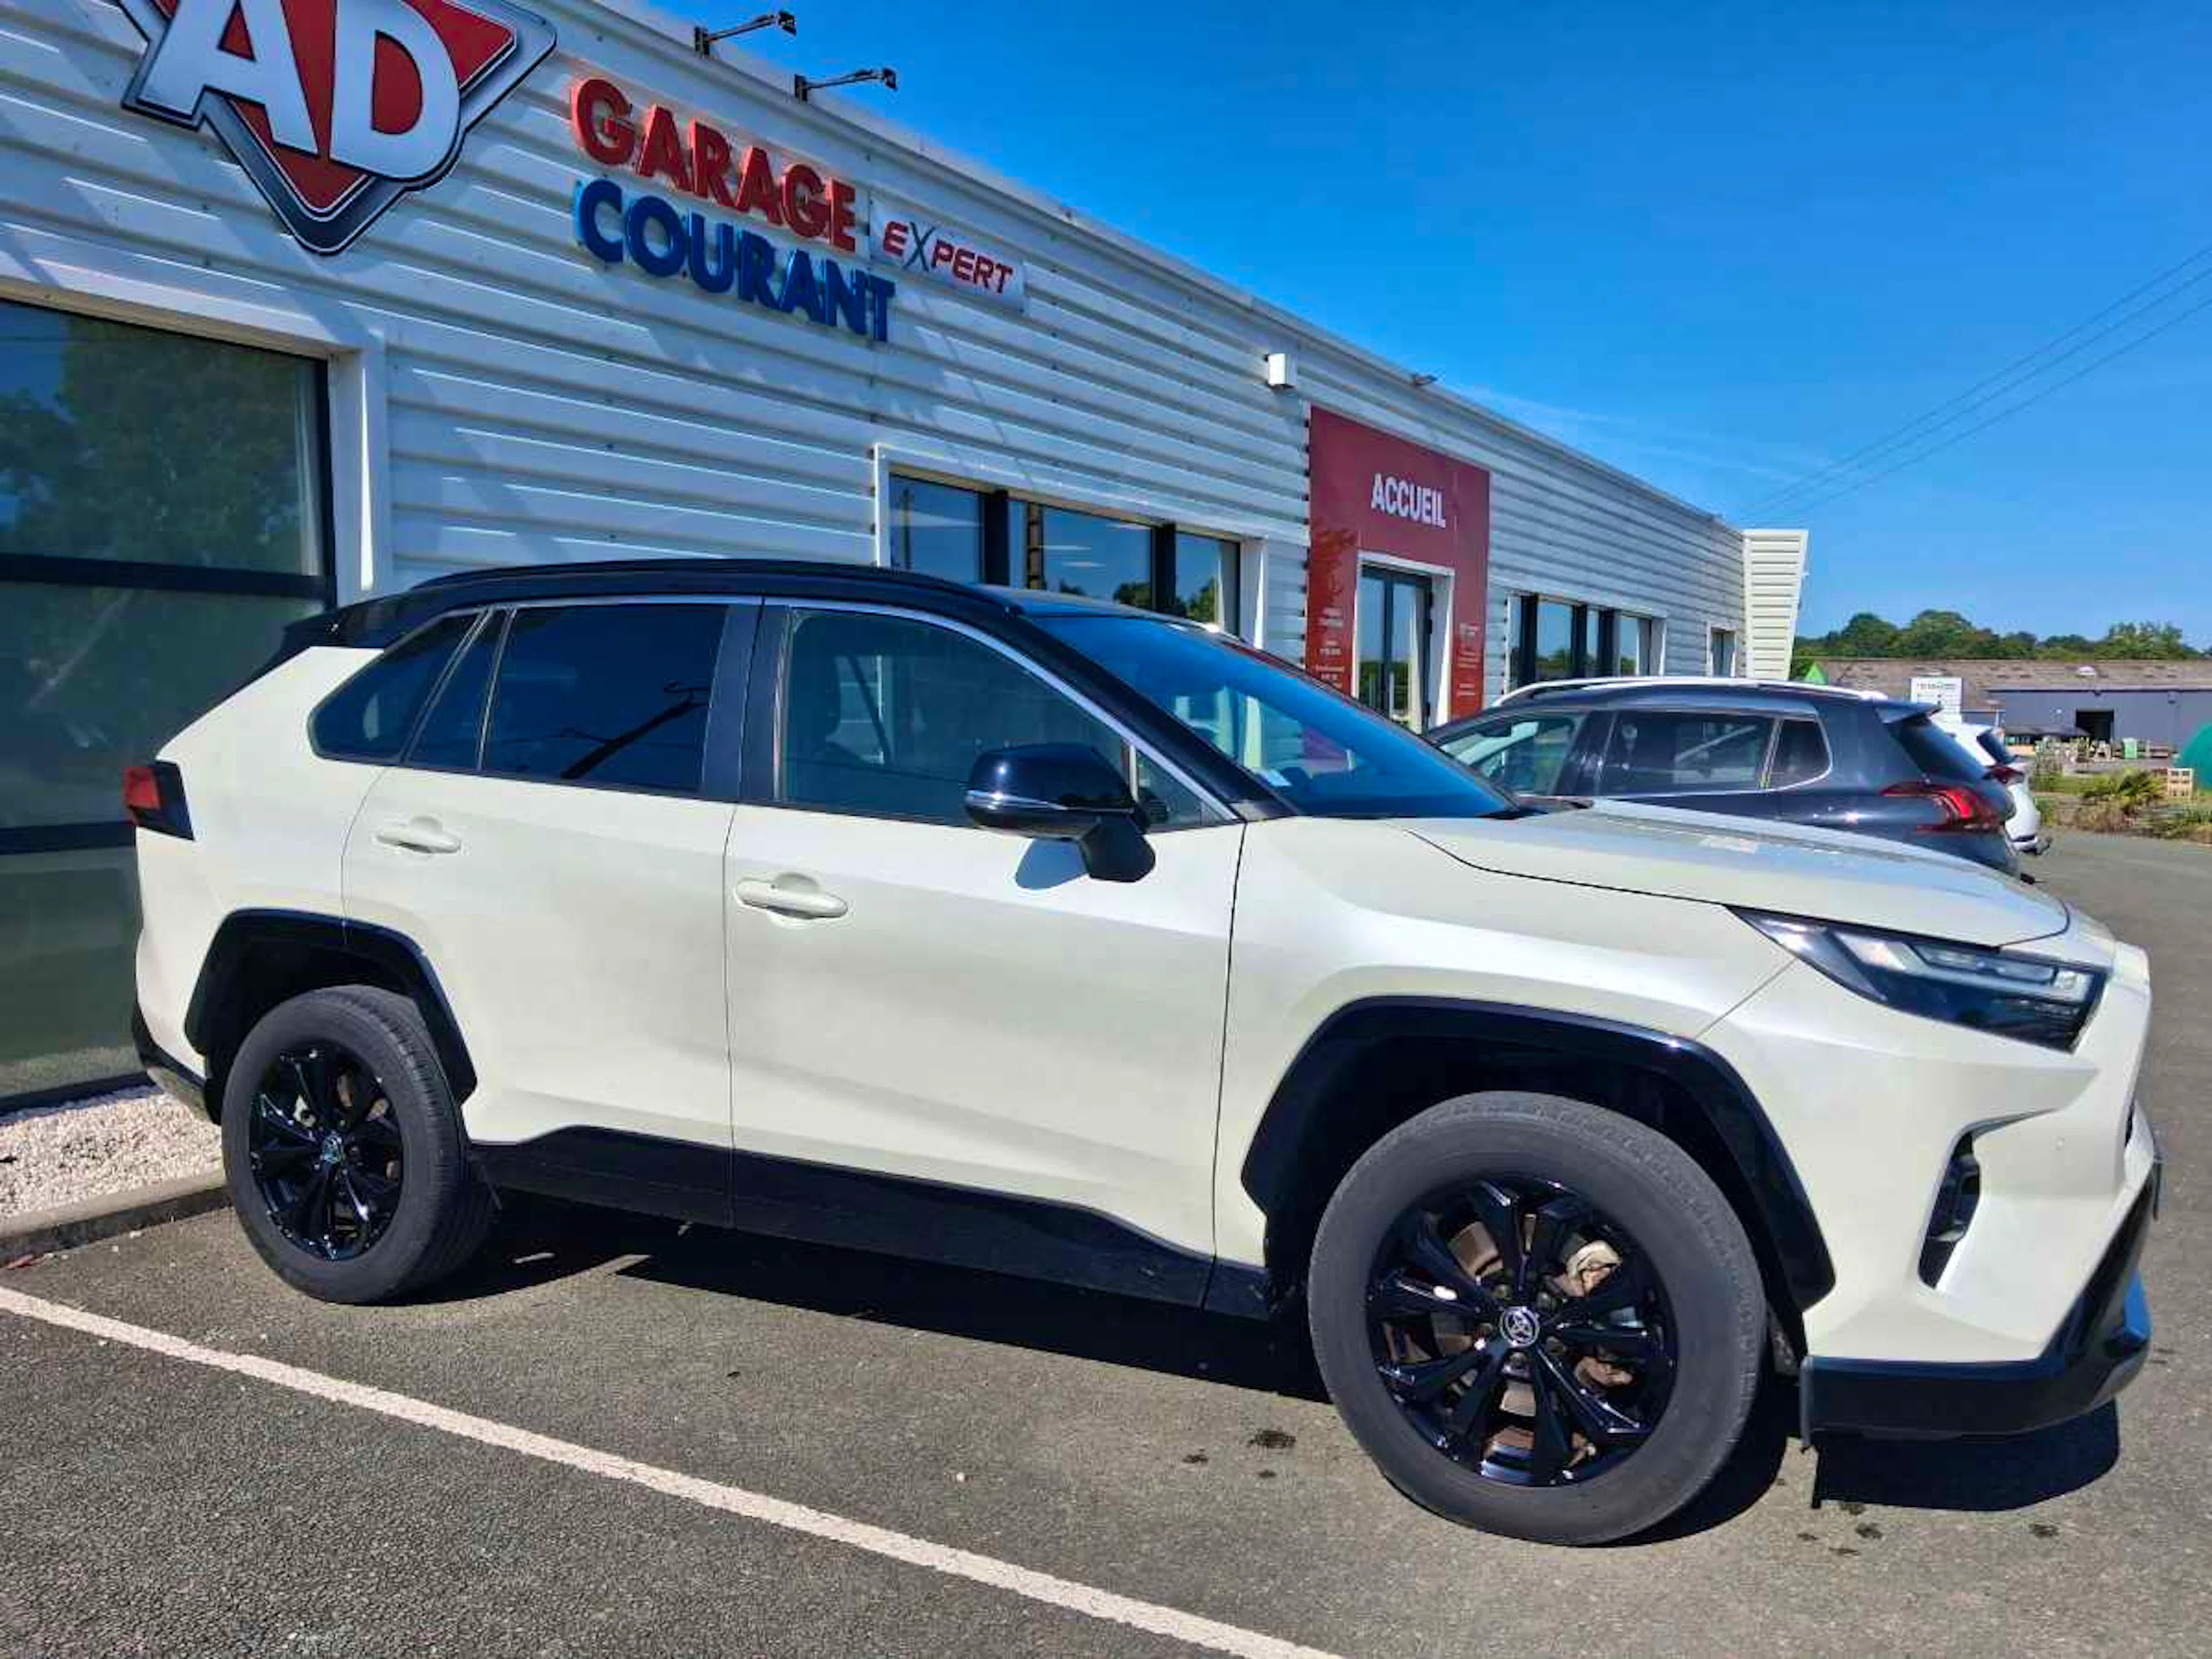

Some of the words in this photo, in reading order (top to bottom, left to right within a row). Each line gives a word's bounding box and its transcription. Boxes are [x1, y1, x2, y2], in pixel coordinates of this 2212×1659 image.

[137, 0, 460, 179] AD
[571, 78, 856, 253] GARAGE
[577, 179, 895, 342] COURANT
[883, 221, 1013, 293] EXPERT
[1370, 472, 1446, 529] ACCUEIL
